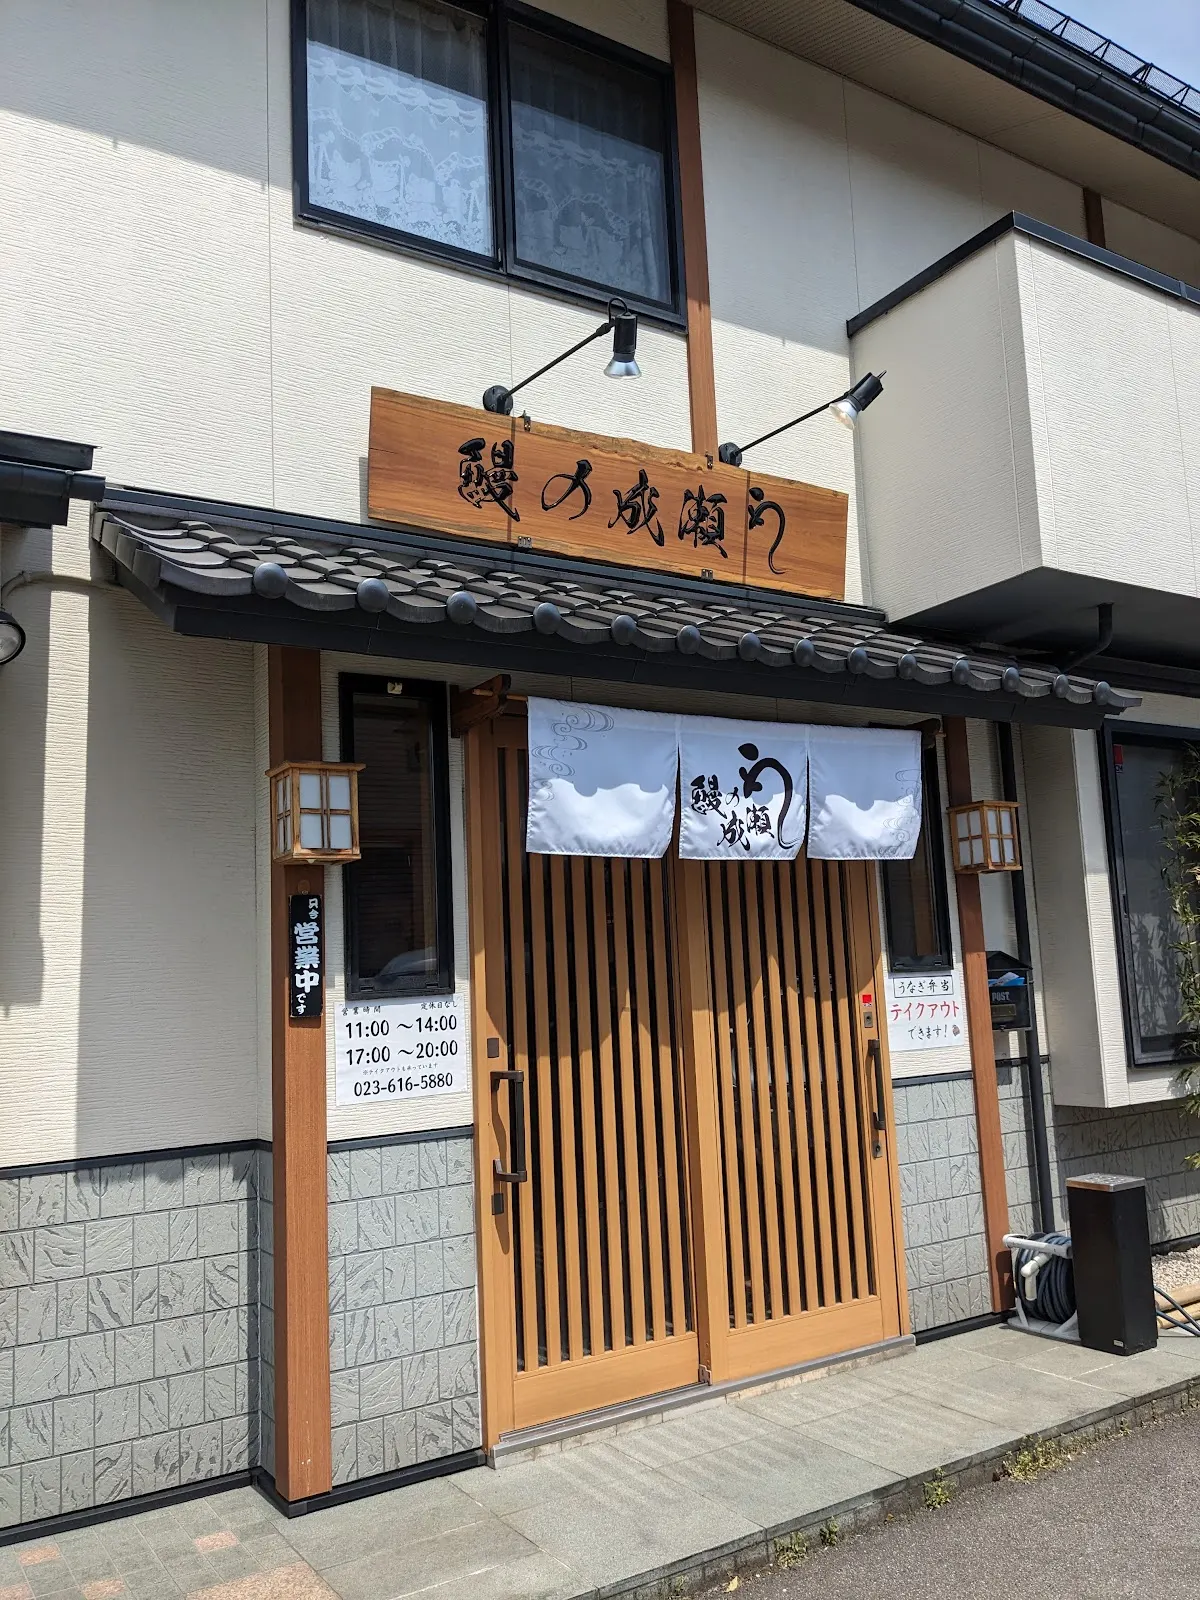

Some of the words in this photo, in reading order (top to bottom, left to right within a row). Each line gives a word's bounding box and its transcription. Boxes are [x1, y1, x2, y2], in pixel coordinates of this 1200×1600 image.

[898, 979, 950, 994] うなぎ弁当
[992, 991, 1010, 1002] POST
[341, 1005, 381, 1016] 営業時間
[421, 1001, 458, 1011] 定休日なし
[890, 1000, 960, 1021] テイクアウト
[345, 1019, 390, 1039] 11:00
[346, 1046, 391, 1066] 17:00
[354, 1072, 453, 1097] 023-616-5880
